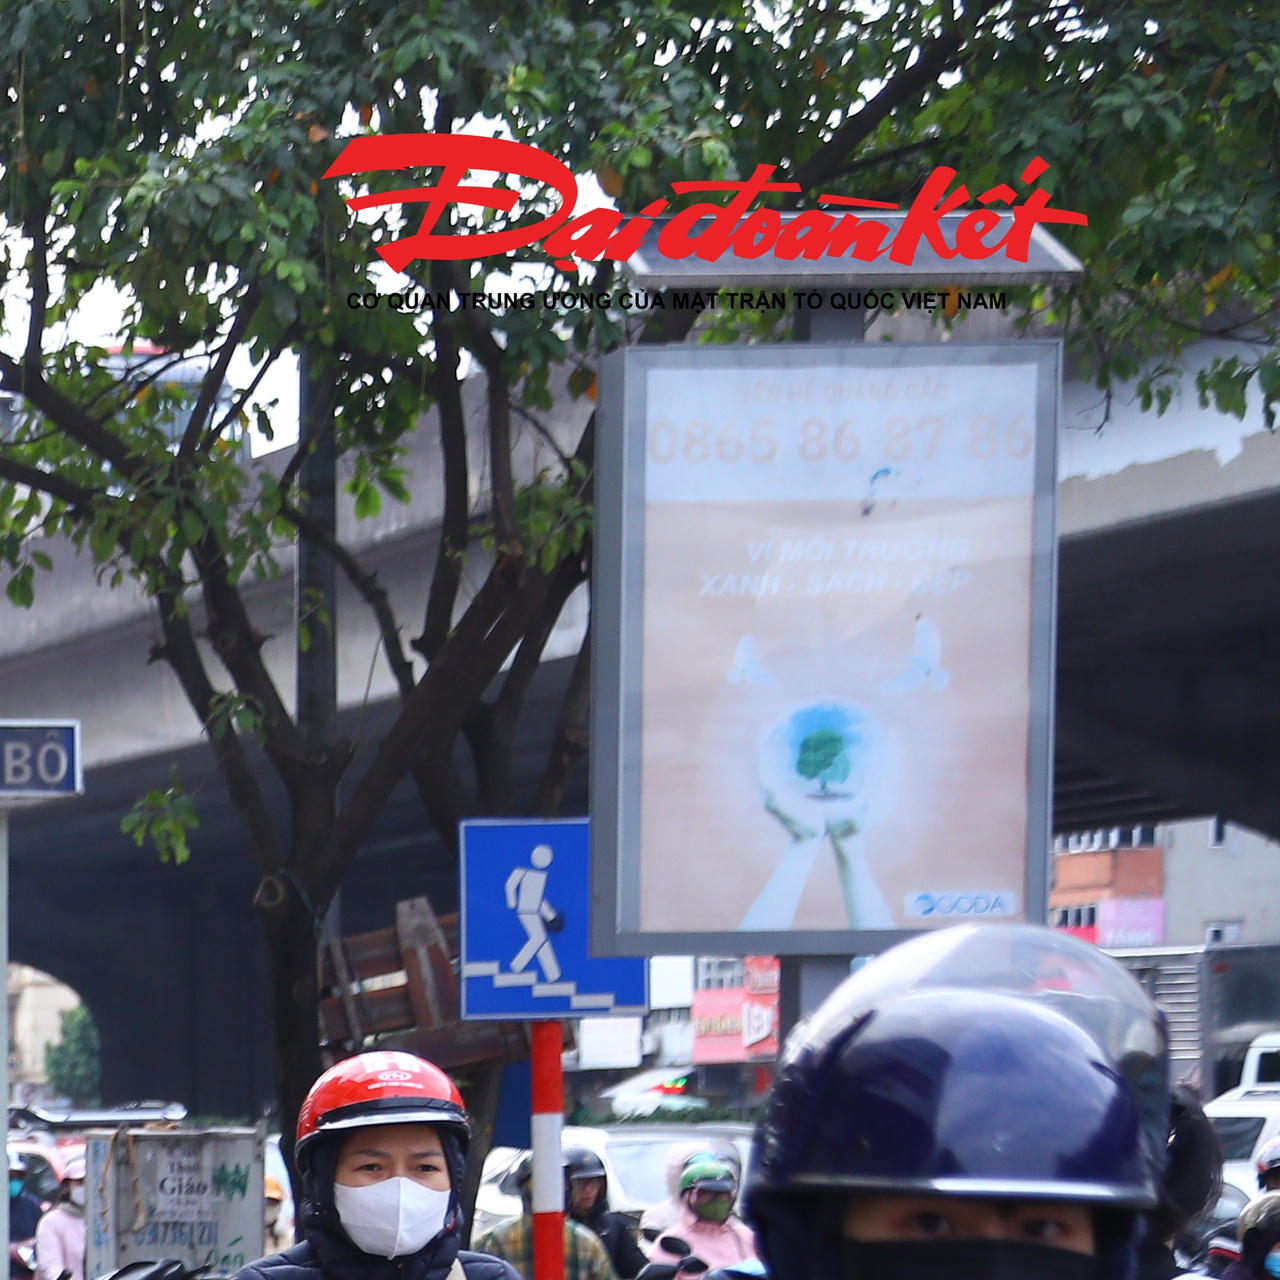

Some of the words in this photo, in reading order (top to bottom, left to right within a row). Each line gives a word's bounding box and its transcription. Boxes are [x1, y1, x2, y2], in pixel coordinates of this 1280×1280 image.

[648, 420, 779, 465] 0865
[799, 418, 863, 464] 86
[883, 416, 946, 463] 87
[969, 415, 1034, 461] 86
